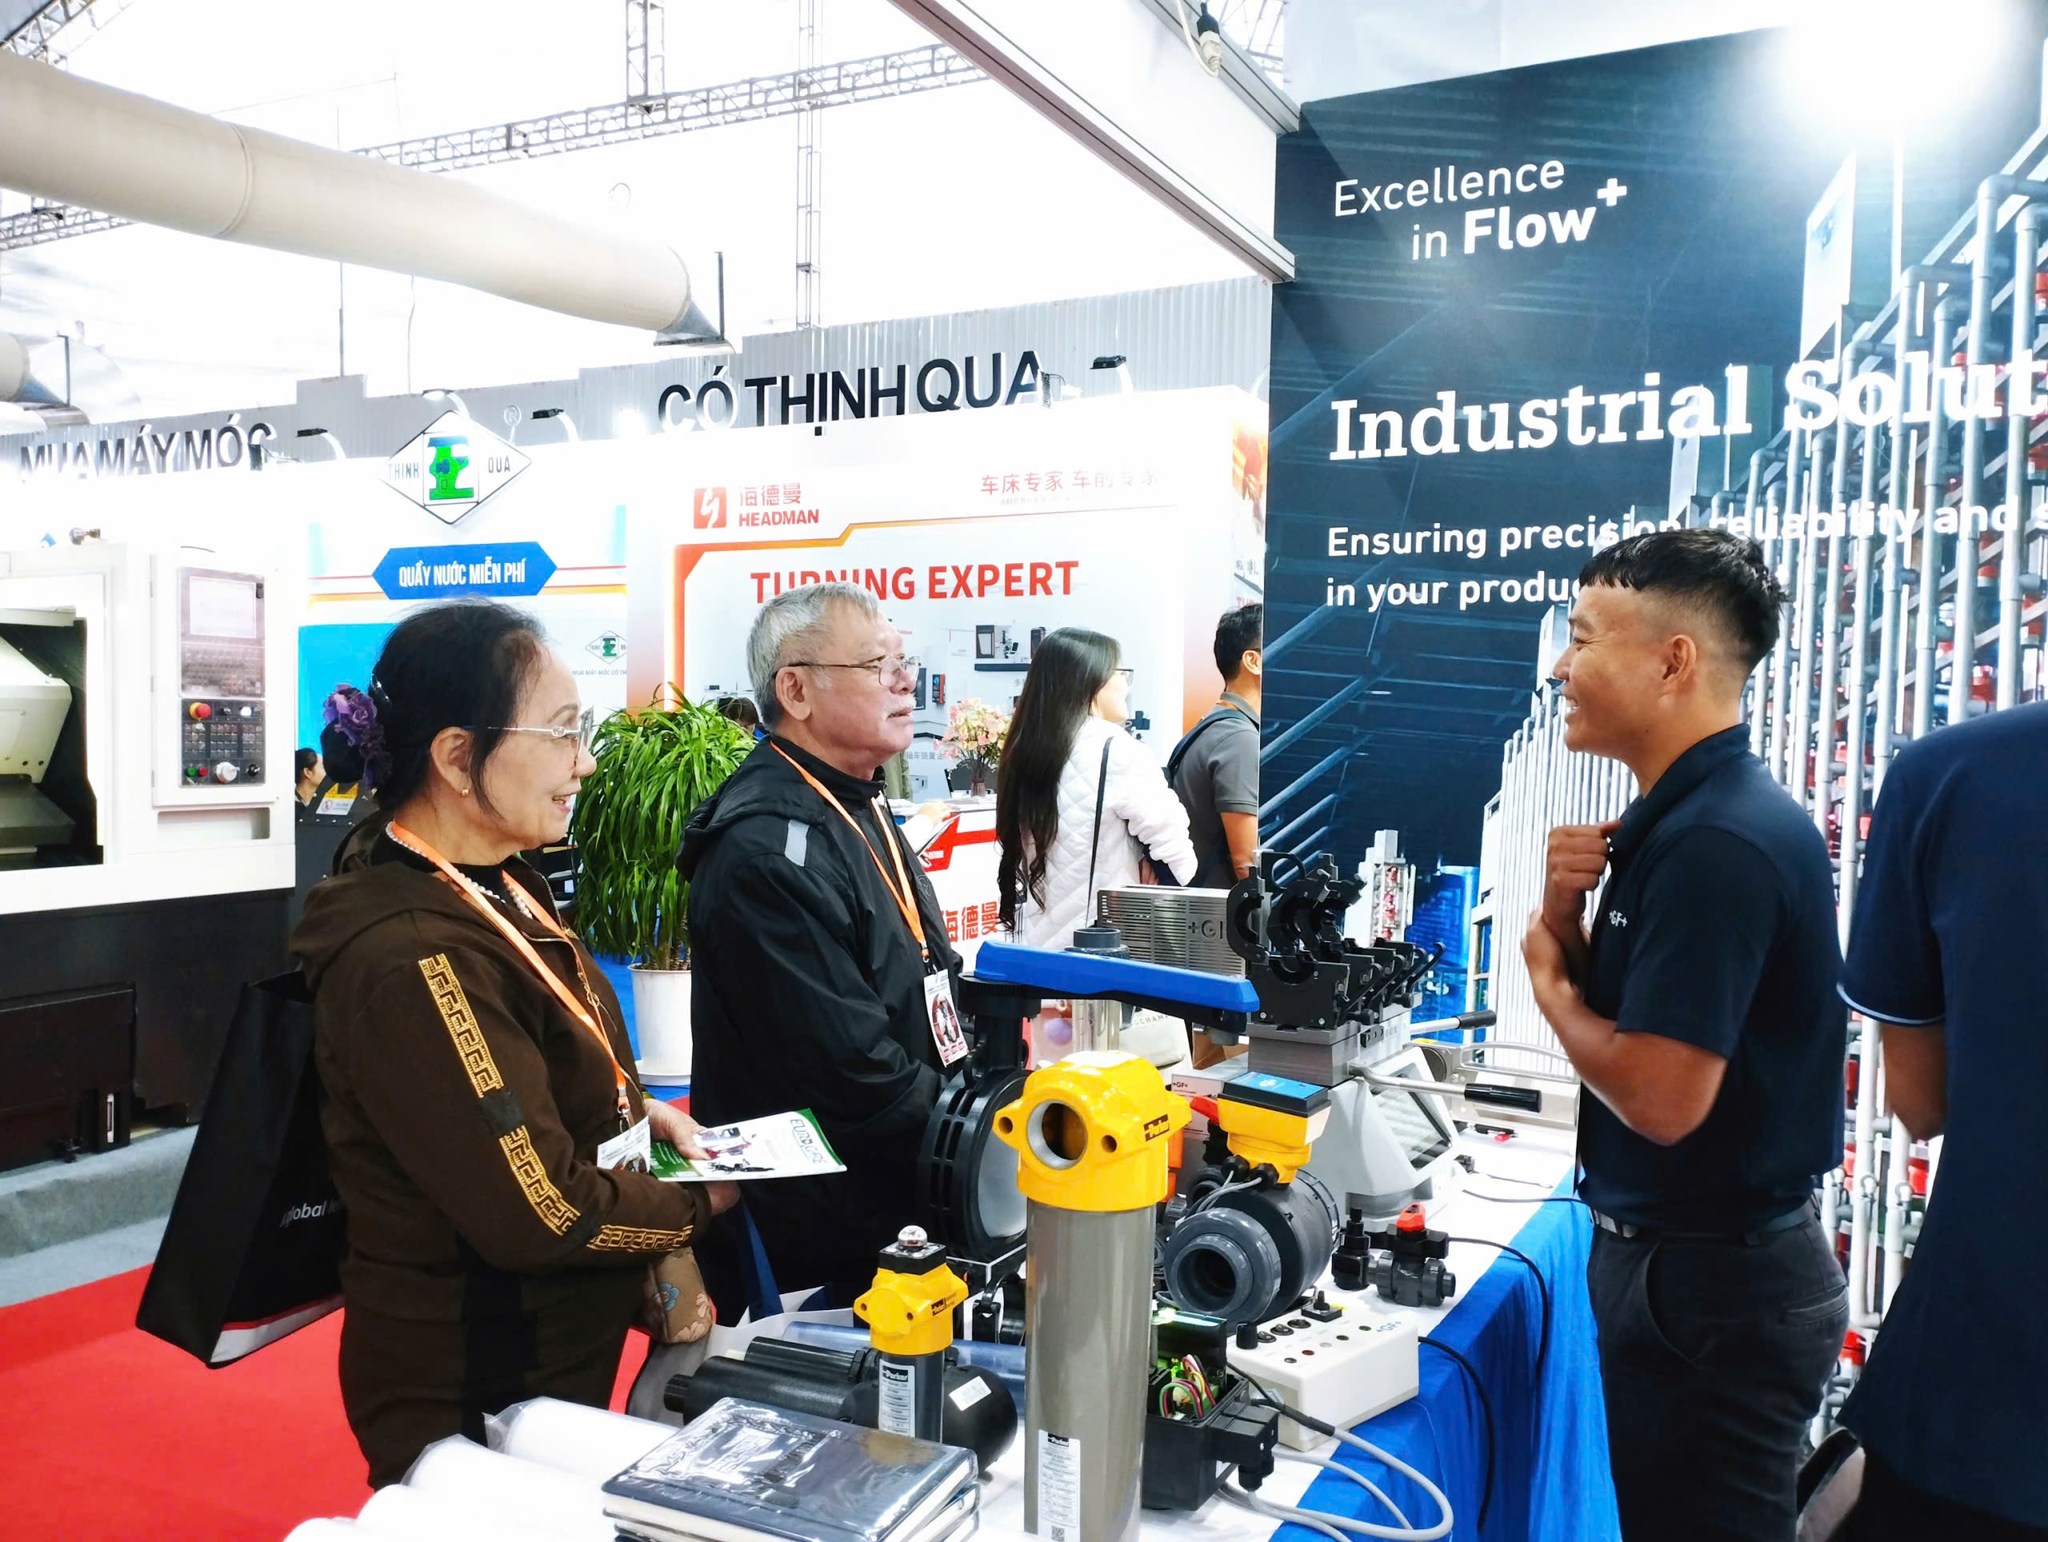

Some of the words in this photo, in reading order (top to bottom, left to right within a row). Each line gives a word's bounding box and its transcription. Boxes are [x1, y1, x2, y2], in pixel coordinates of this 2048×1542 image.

[1335, 160, 1565, 217] Excellence
[1412, 224, 1447, 260] in
[657, 365, 738, 433] CÓ
[744, 363, 908, 436] THỊNH
[1329, 363, 1752, 461] Industrial
[20, 441, 97, 479] MUA
[100, 424, 179, 476] MÁY
[739, 509, 819, 527] HEADMAN
[1328, 523, 1487, 559] Ensuring
[1709, 501, 1920, 542] reliability
[1933, 495, 2018, 534] and
[504, 557, 526, 583] PHÍ
[928, 560, 1079, 599] EXPERT
[1326, 577, 1356, 606] in
[1367, 580, 1448, 612] your
